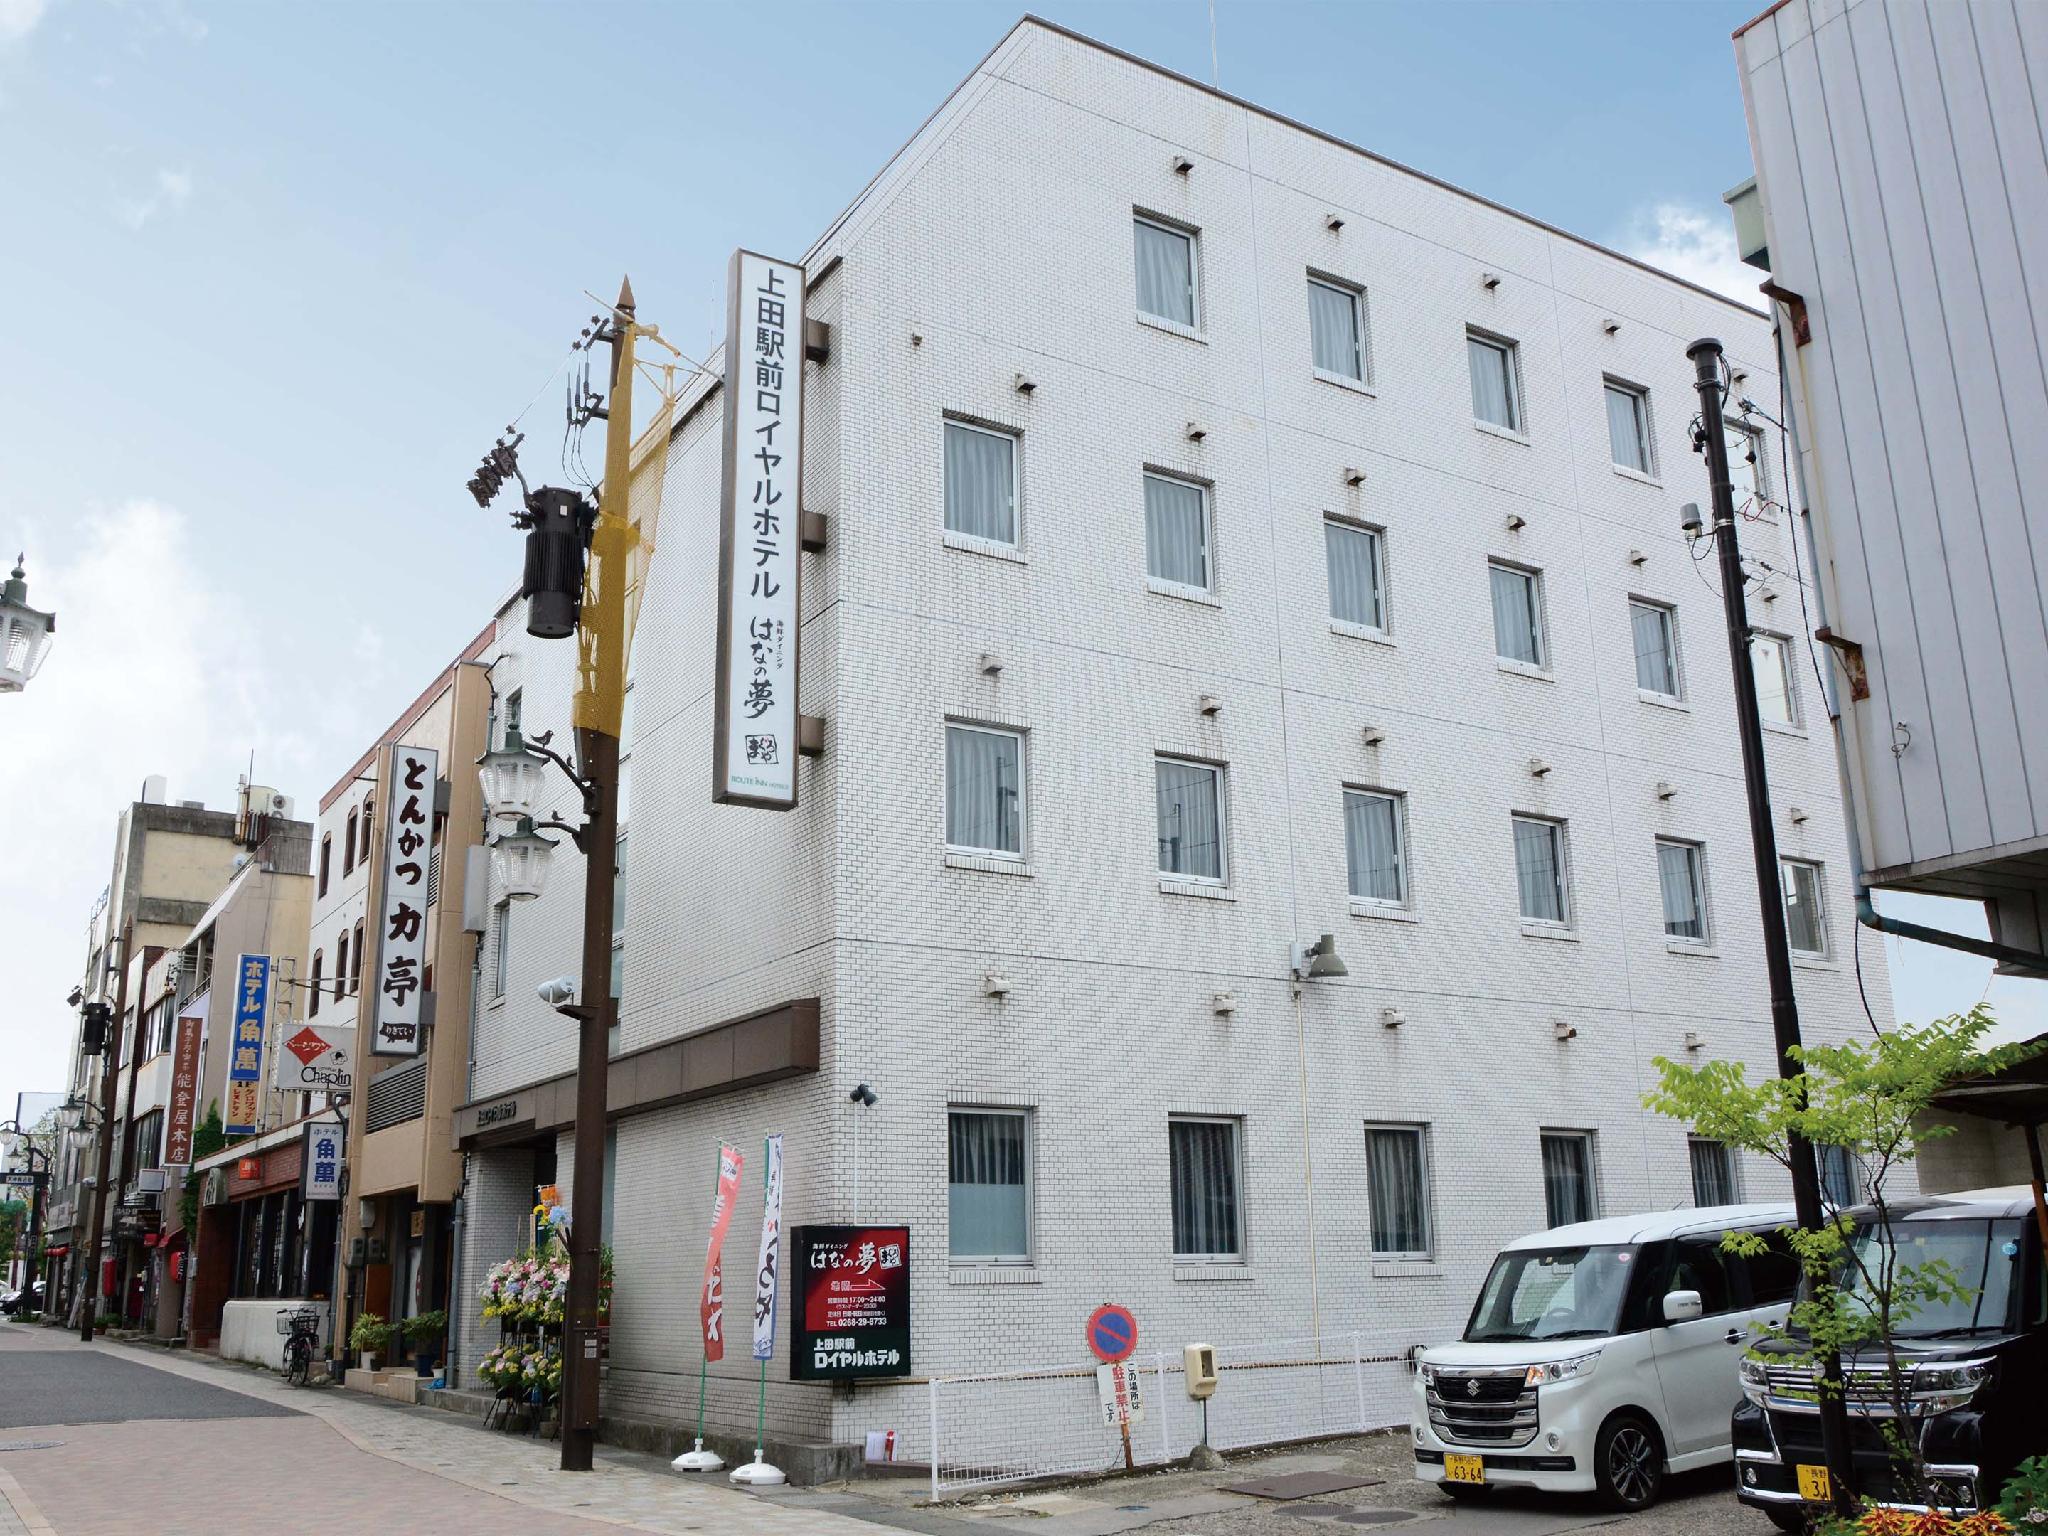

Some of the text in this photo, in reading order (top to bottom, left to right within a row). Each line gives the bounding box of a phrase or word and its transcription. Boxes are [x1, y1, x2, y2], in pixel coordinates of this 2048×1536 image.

[751, 268, 785, 599] 上田駅前ロイヤルホテル
[744, 616, 775, 719] はなの夢
[731, 776, 753, 785] ROUTE
[383, 757, 427, 1008] とんかつ 力亭
[243, 961, 264, 1014] ホテル
[301, 1066, 352, 1089] Chaplin
[171, 1072, 193, 1162] 能登屋本店
[811, 1242, 876, 1274] はなの夢
[814, 1338, 855, 1351] 上田駅前
[814, 1349, 900, 1369] ロイヤルホテル
[1112, 1366, 1130, 1422] 駐車禁止
